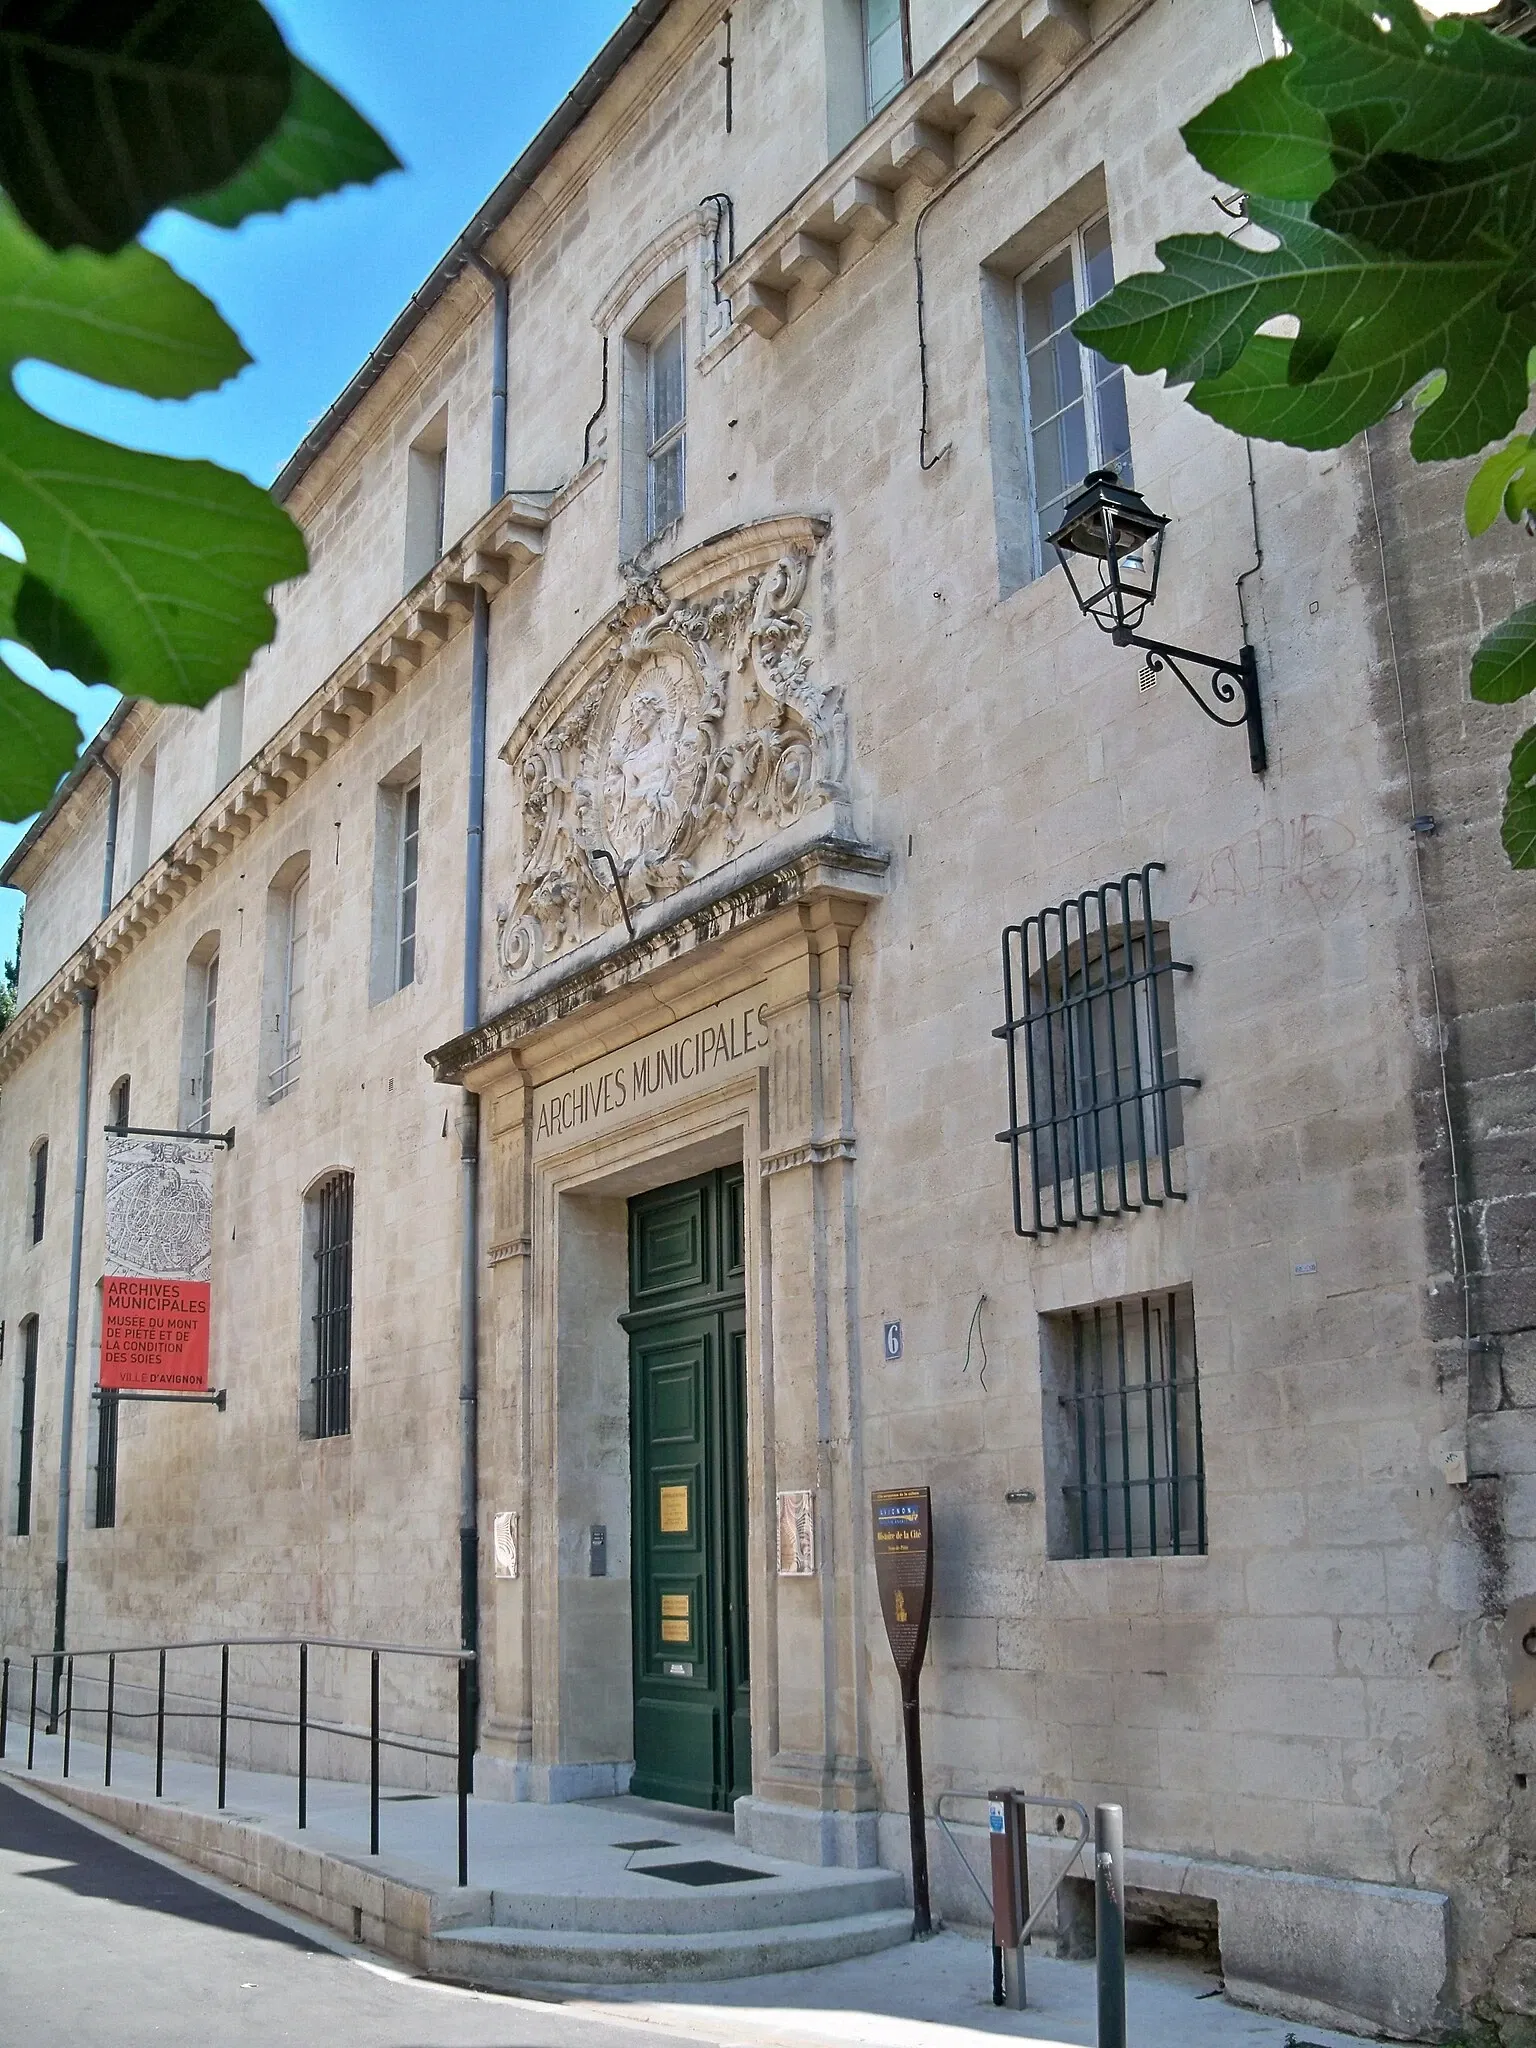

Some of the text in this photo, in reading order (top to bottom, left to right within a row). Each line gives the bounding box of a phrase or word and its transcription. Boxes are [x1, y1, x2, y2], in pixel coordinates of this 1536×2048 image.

[537, 1002, 769, 1142] ARCHIVES MUNICIPALES
[108, 1282, 180, 1298] ARCHIVES
[108, 1294, 206, 1313] MUNICIPALES
[107, 1315, 198, 1330] MUSÉE DU MONT
[106, 1326, 190, 1342] DE PIÉTÉ ET DE
[887, 1324, 899, 1354] 6
[106, 1340, 183, 1352] LA CONDITION
[105, 1352, 162, 1364] DES SOIES
[120, 1372, 203, 1385] VILLE D'AVIGNON
[896, 1531, 903, 1540] de
[903, 1530, 909, 1539] la
[910, 1529, 922, 1539] Cité
